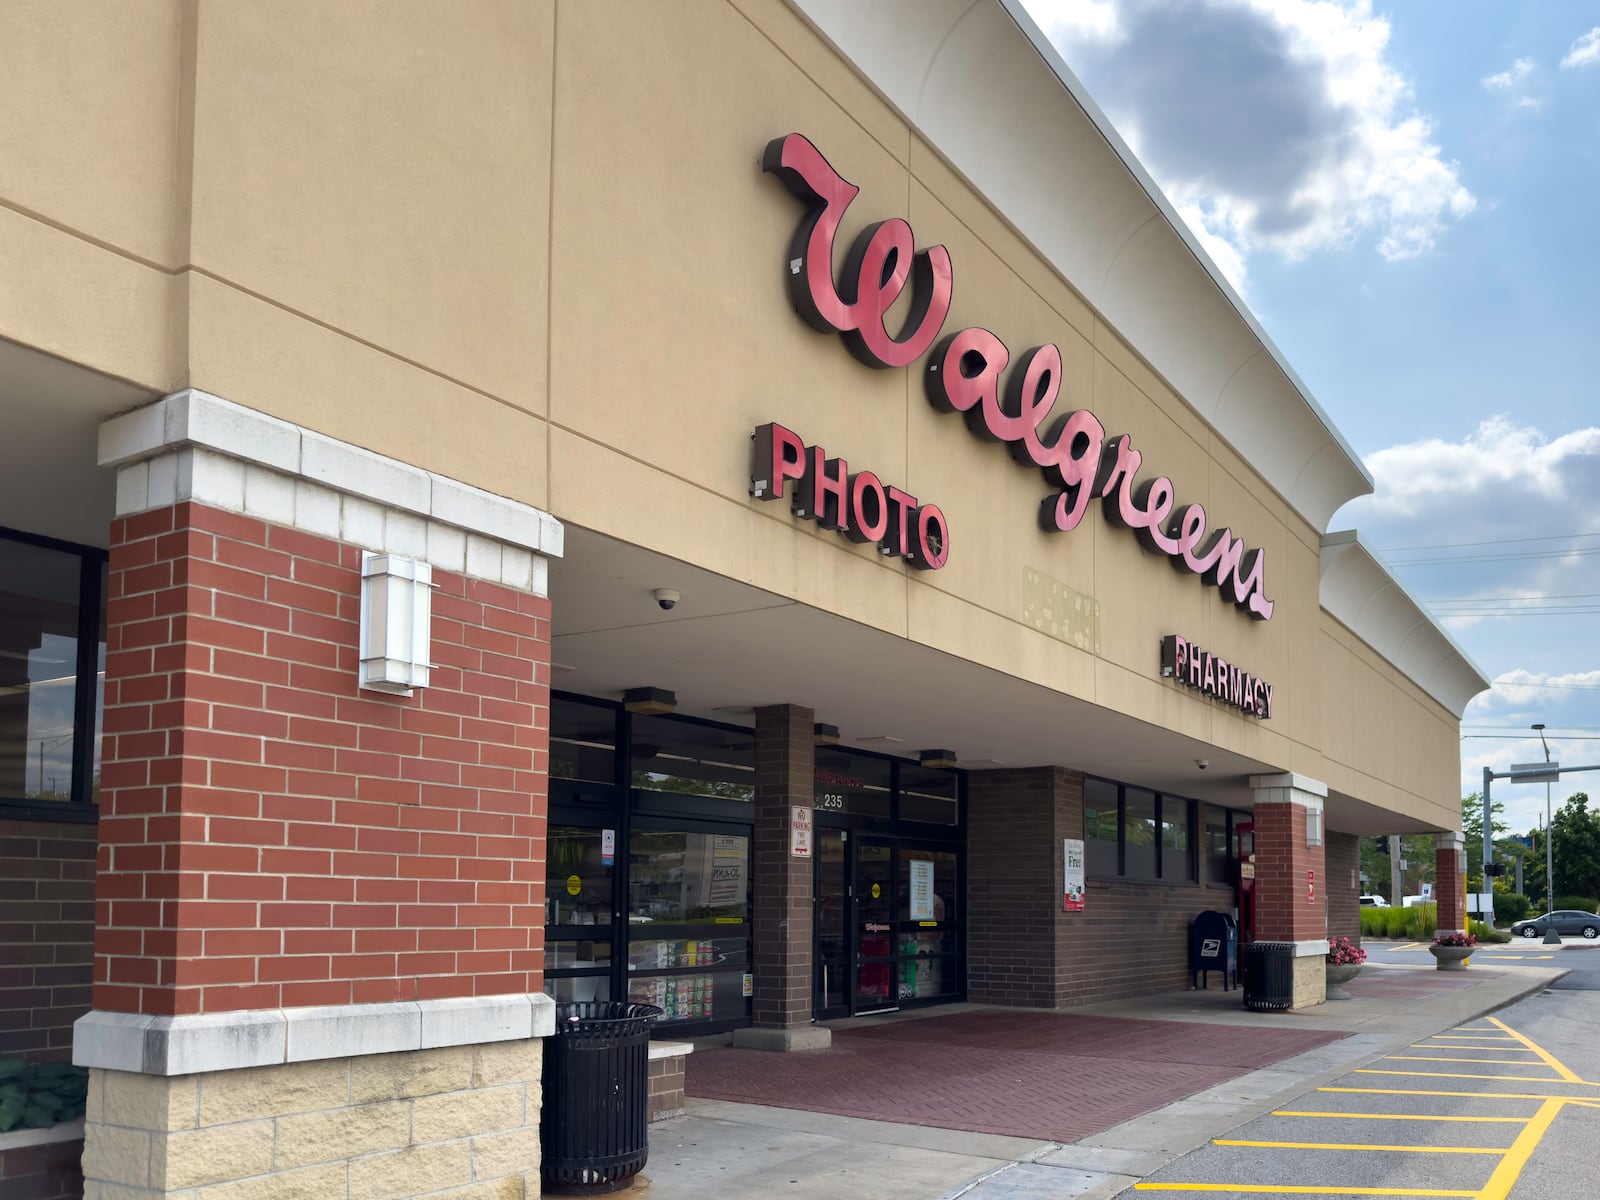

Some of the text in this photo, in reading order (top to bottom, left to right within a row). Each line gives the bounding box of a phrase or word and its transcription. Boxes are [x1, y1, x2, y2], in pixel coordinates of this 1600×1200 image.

[765, 132, 1275, 621] Walgreens
[756, 422, 950, 570] PHOTO
[1167, 634, 1273, 719] PHARMACY
[824, 793, 843, 809] 235
[797, 810, 806, 821] NO
[793, 821, 810, 832] PARKING
[1068, 855, 1082, 868] Free
